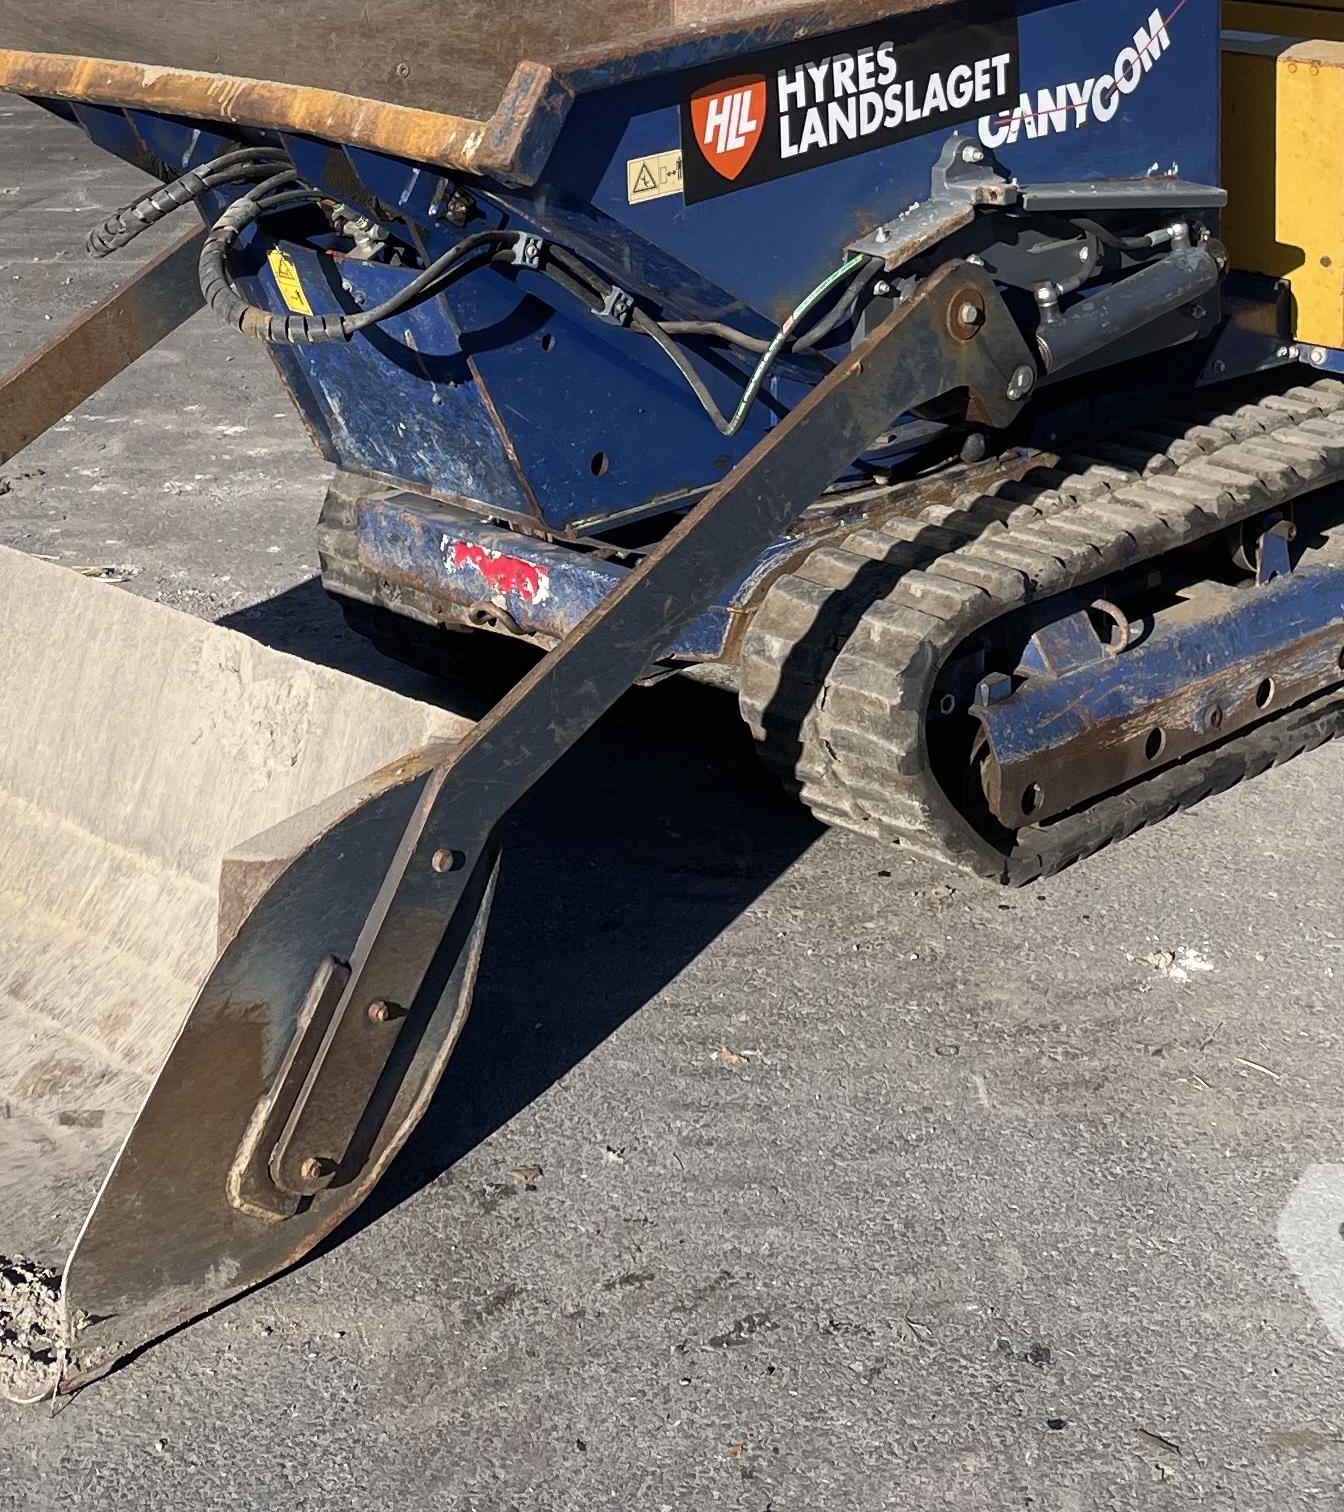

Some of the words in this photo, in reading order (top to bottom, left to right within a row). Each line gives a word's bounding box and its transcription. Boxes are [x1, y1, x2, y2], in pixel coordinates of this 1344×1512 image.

[777, 40, 898, 113] HYRES
[780, 53, 1010, 159] LANDSLAGET
[977, 7, 1171, 149] CANYCOM
